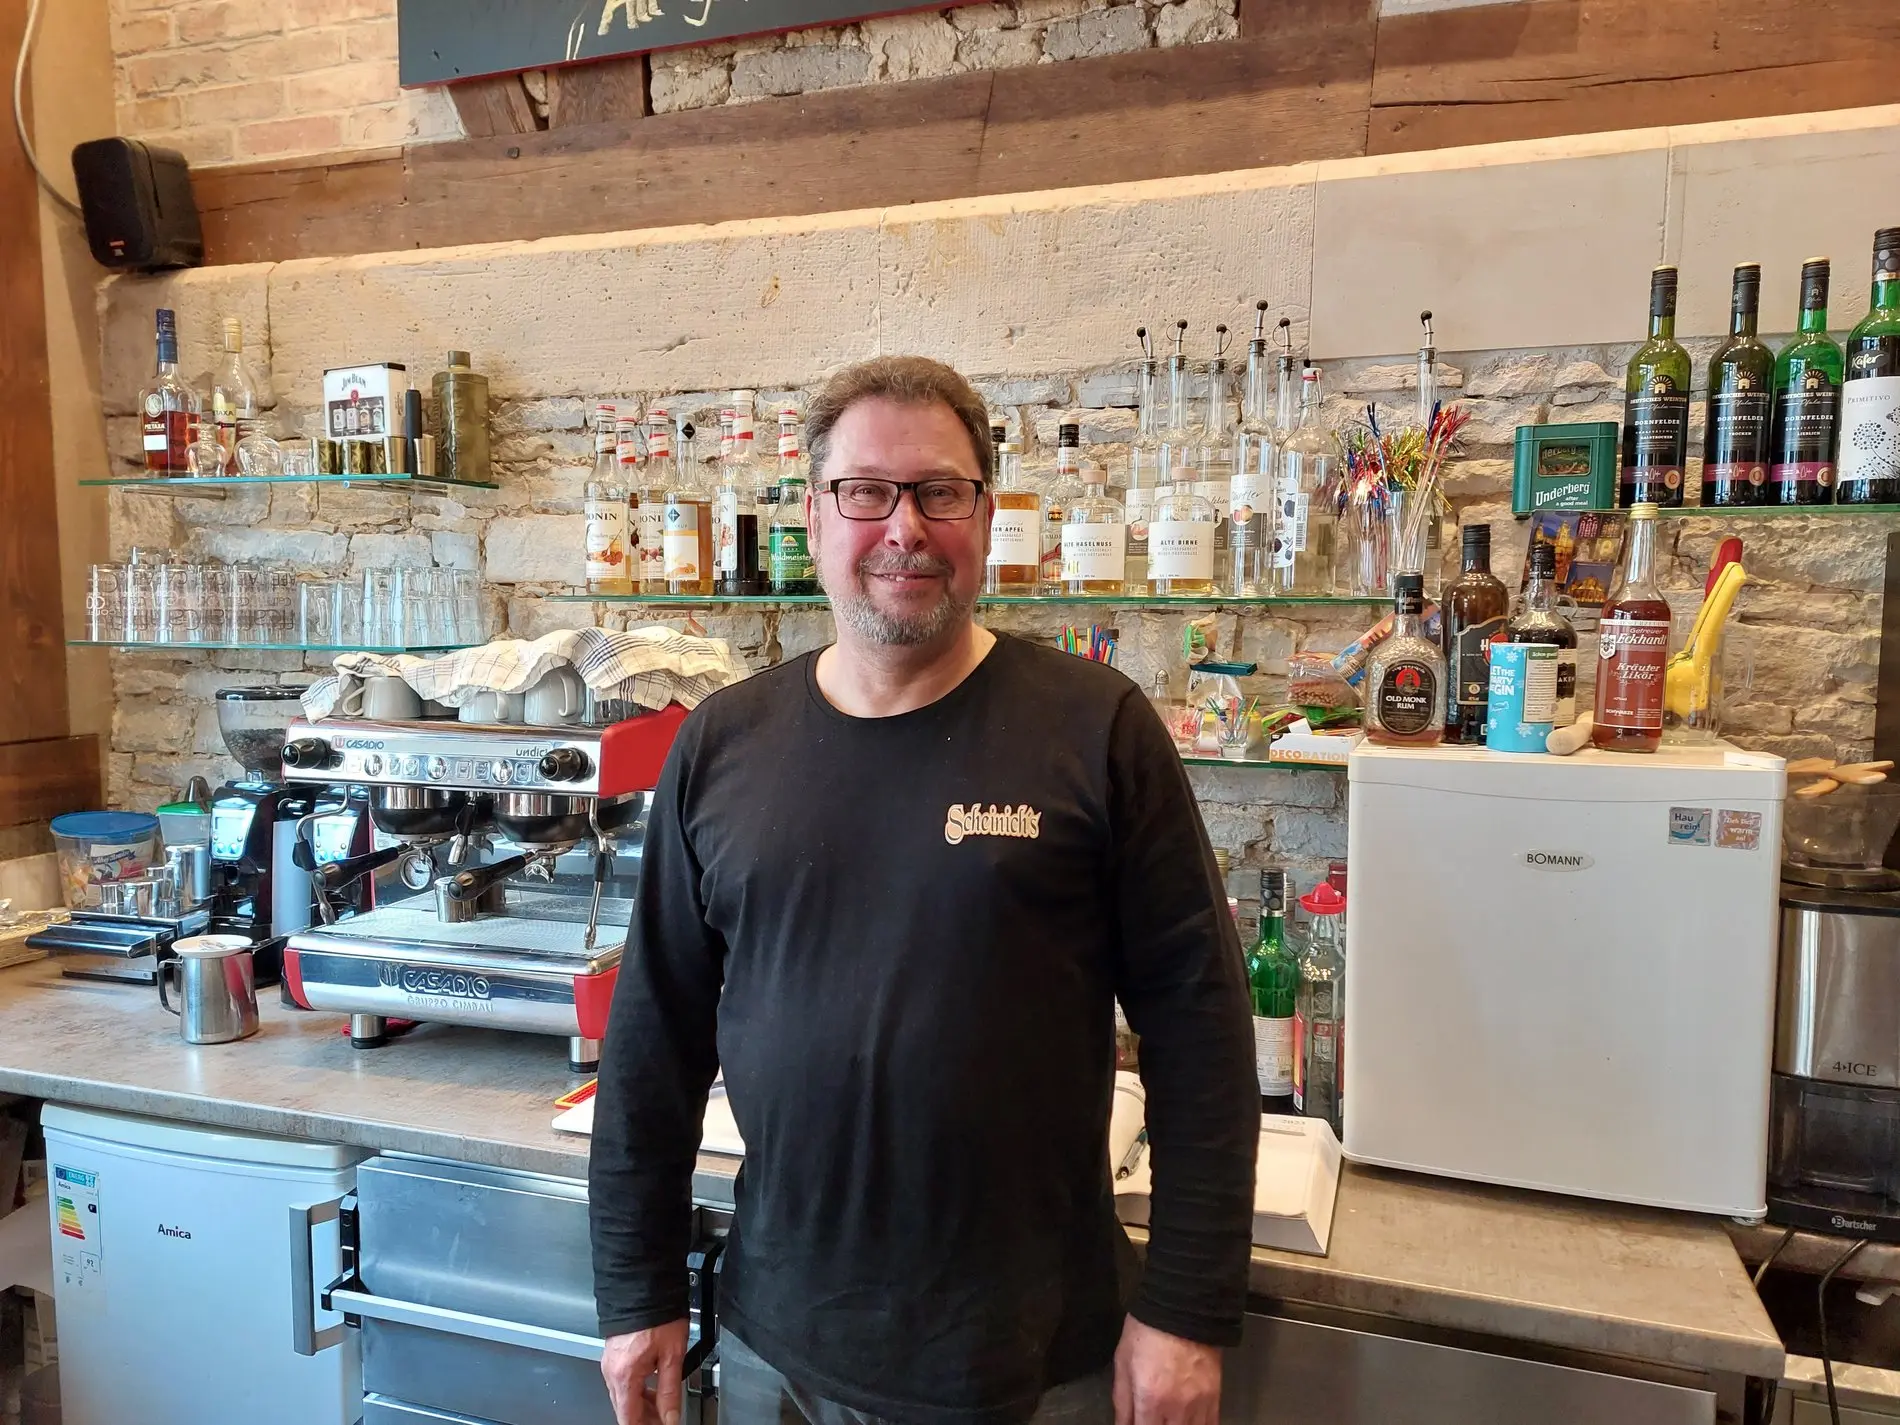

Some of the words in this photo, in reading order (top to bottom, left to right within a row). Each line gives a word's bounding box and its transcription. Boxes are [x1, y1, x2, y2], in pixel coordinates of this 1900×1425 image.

[341, 377, 352, 391] JIM
[352, 373, 367, 388] BEAM
[1847, 395, 1891, 404] PRIMITIVO
[1785, 414, 1833, 422] DORNFELDER
[1536, 483, 1590, 506] Underberg
[640, 514, 663, 522] ONI
[1630, 627, 1663, 635] Getreuer
[1615, 632, 1667, 645] Eckhardt
[1616, 662, 1661, 672] Kräuter
[1501, 668, 1516, 677] THE
[1622, 670, 1654, 680] Likör
[1402, 695, 1427, 704] MONK
[1396, 702, 1415, 710] RUM
[346, 739, 384, 750] CASADIO
[1270, 749, 1350, 762] DECORATION
[1674, 813, 1694, 822] Hau
[944, 802, 1042, 845] Scheinich's
[1730, 827, 1753, 835] warm
[1526, 853, 1581, 866] BOMANN
[403, 970, 490, 999] CASADIO
[408, 995, 448, 1008] GRUPPO
[453, 999, 494, 1013] CIMBALI
[58, 1182, 71, 1190] Amica
[1831, 1215, 1878, 1231] Bartscher
[157, 1223, 192, 1240] Amica
